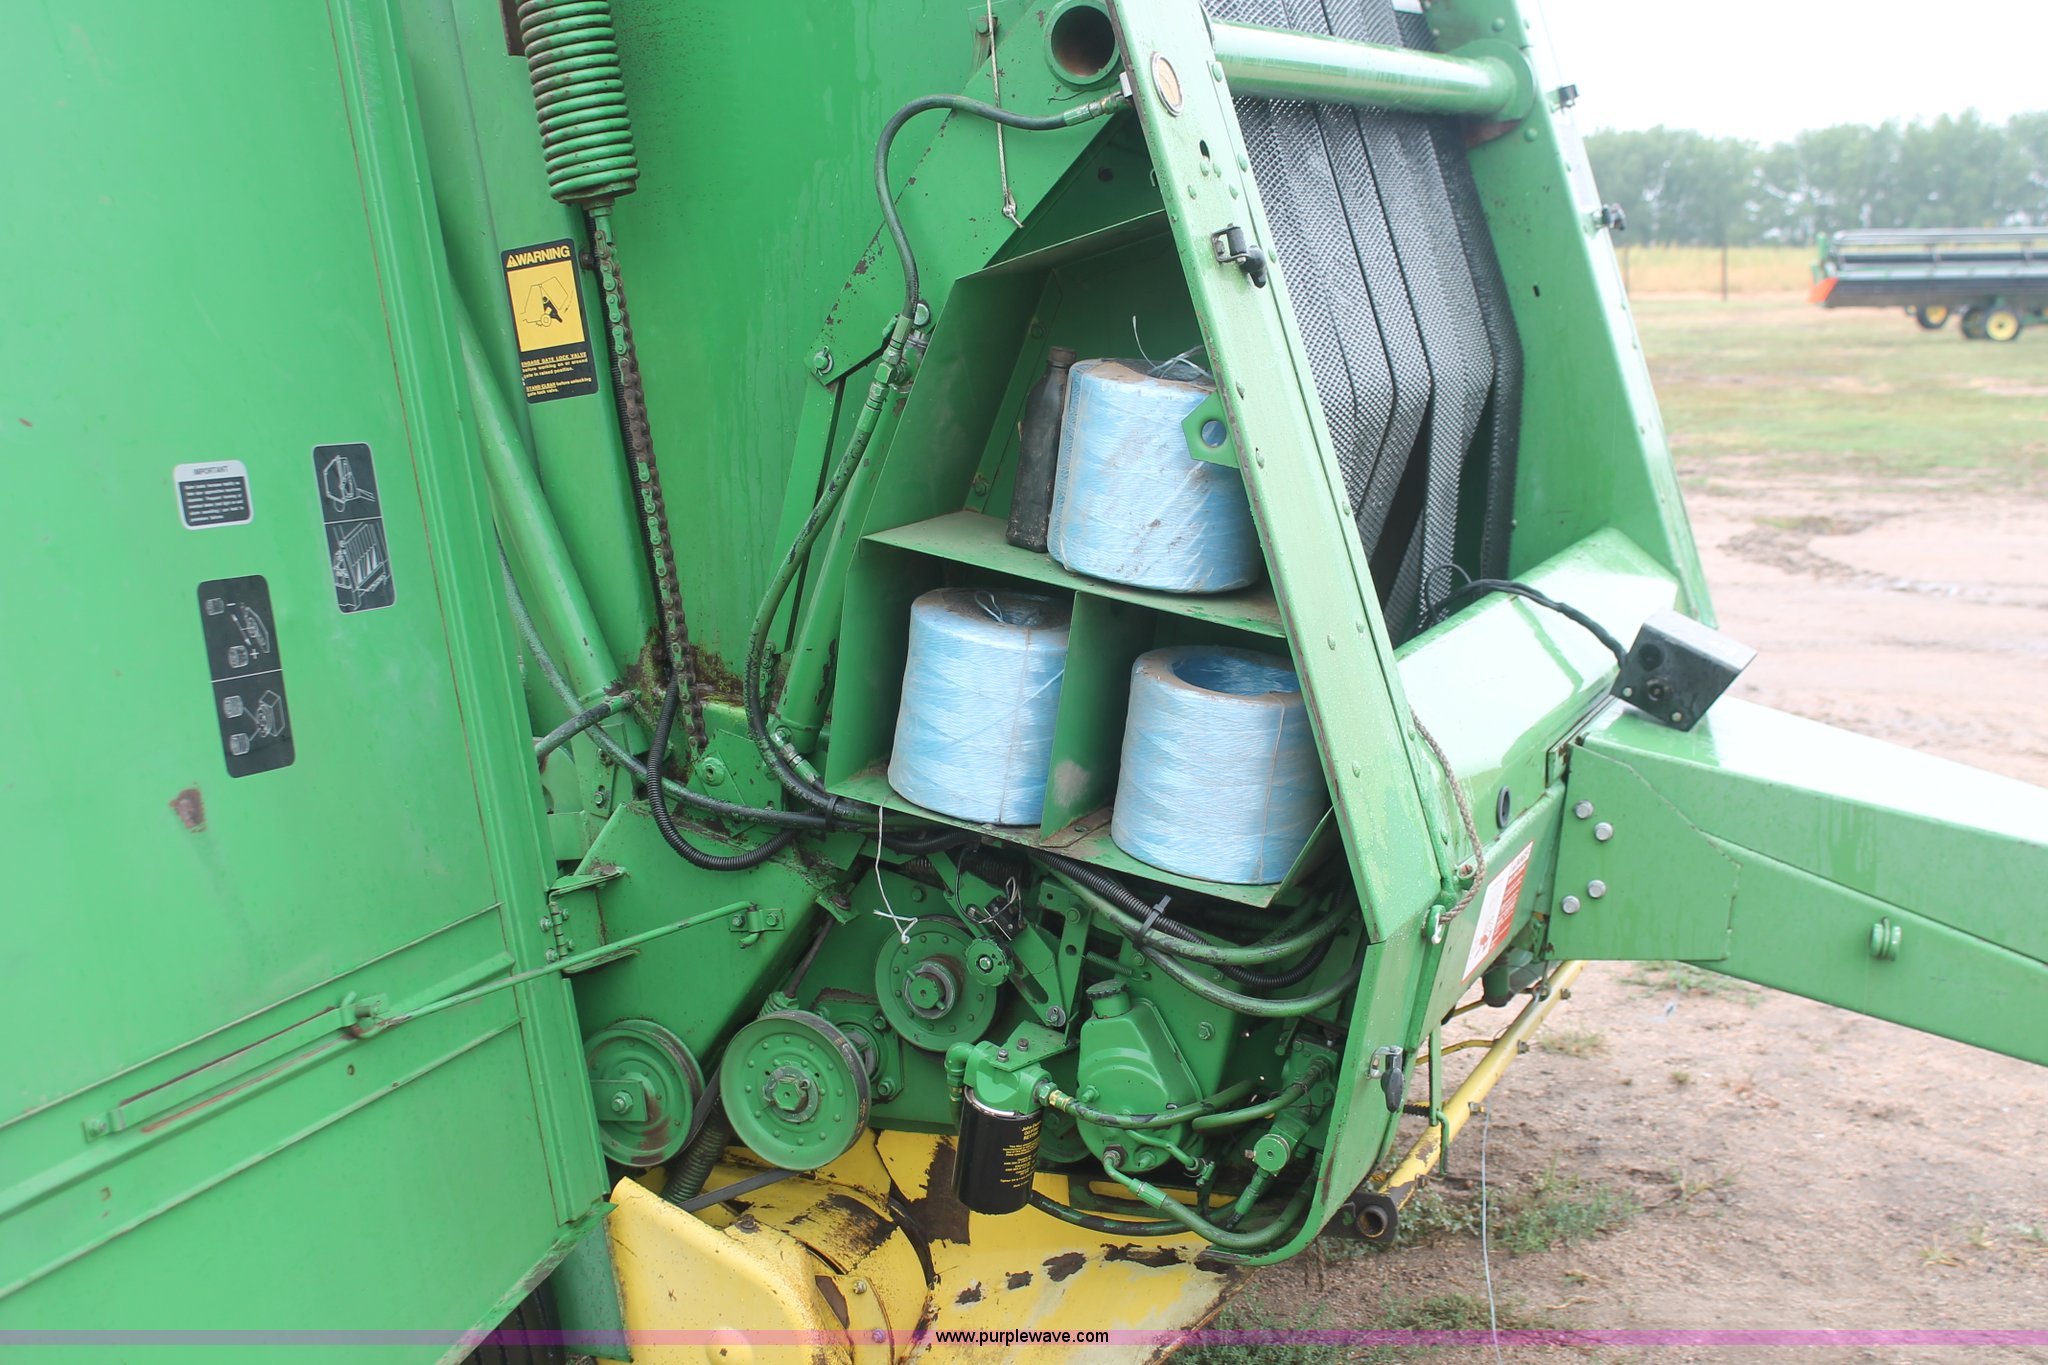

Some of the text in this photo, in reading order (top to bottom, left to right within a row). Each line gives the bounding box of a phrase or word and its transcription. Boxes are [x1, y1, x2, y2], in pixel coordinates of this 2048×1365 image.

[515, 245, 571, 266] WARNING
[570, 351, 587, 359] VALVE
[193, 465, 229, 475] IMPORTANT
